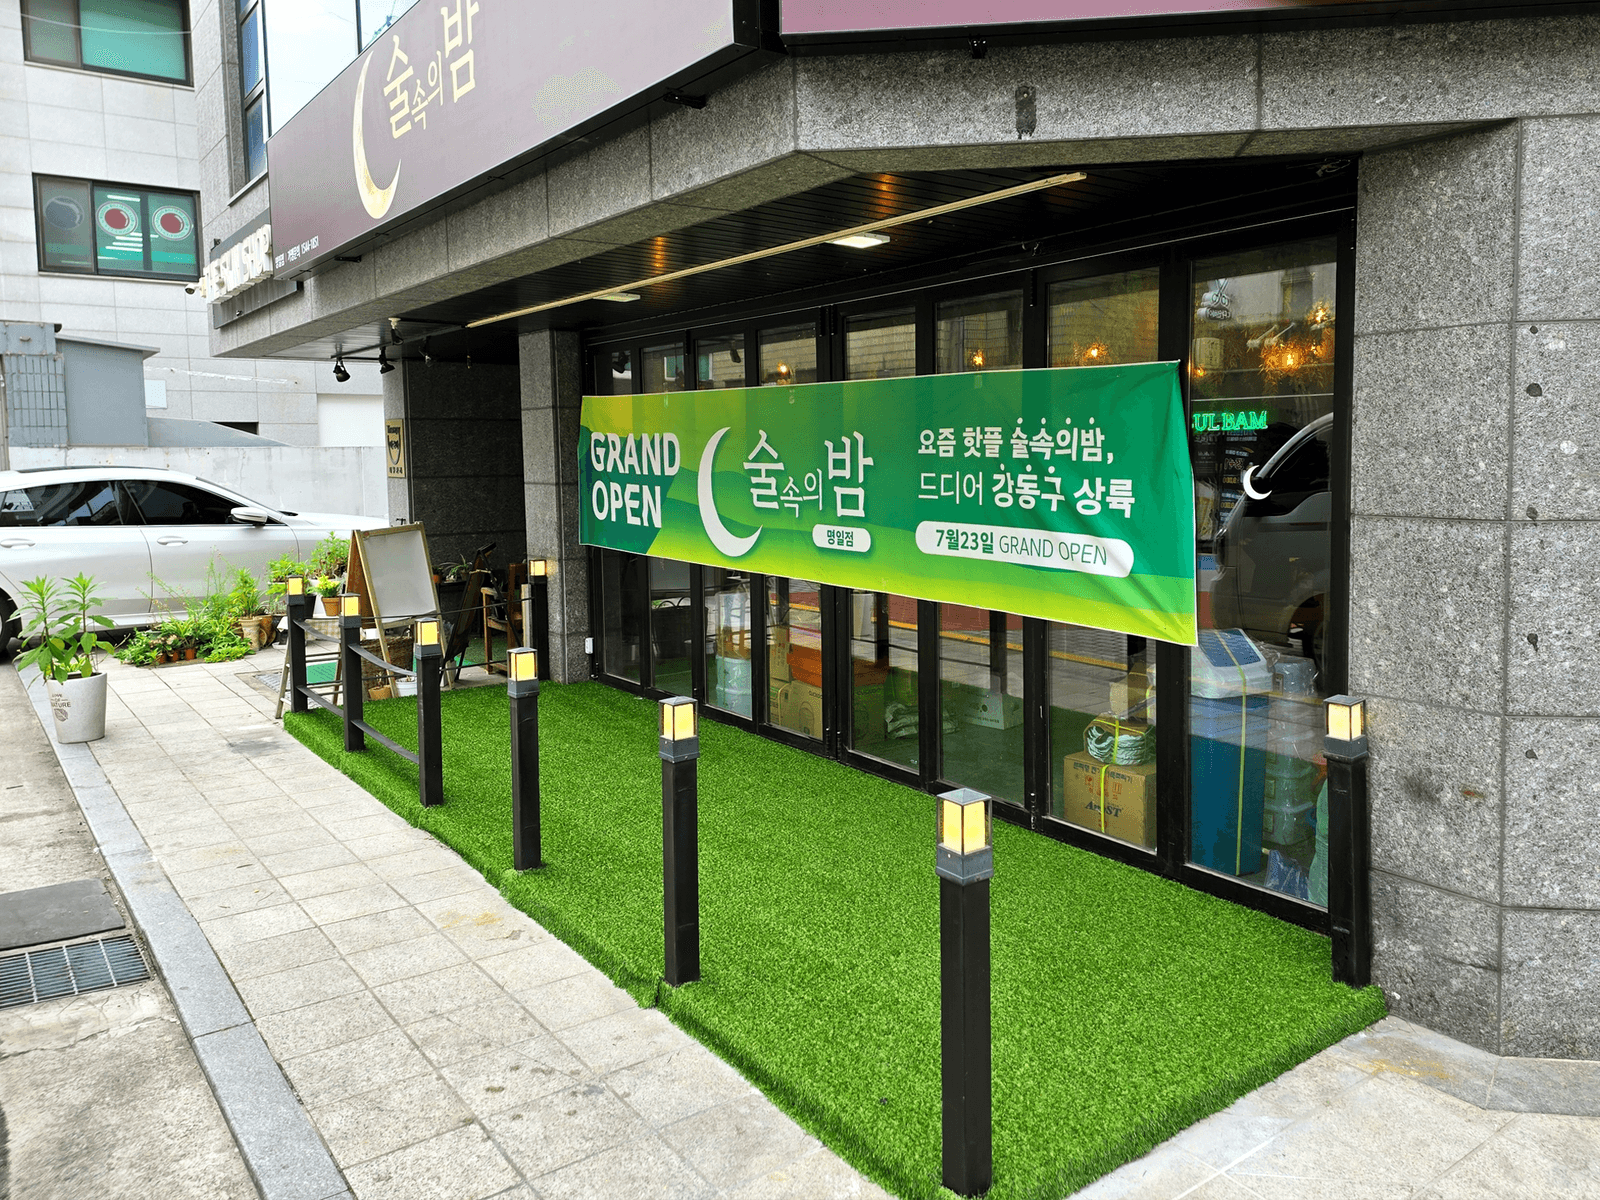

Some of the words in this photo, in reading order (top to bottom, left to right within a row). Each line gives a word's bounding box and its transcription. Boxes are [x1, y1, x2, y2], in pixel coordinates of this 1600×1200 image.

[383, 0, 480, 139] 술속의밤
[590, 431, 681, 477] GRAND
[917, 427, 957, 458] 요즘
[963, 426, 1004, 458] 핫플
[1009, 422, 1114, 464] 술속의밤,
[742, 429, 874, 518] 술속의밤
[917, 470, 983, 506] 드디어
[991, 468, 1066, 513] 강동구
[1073, 477, 1136, 519] 상륙
[591, 479, 663, 529] OPEN
[826, 529, 854, 548] 명일점
[935, 528, 995, 555] 7월23일
[999, 535, 1054, 559] GRAND
[1058, 541, 1108, 566] OPEN
